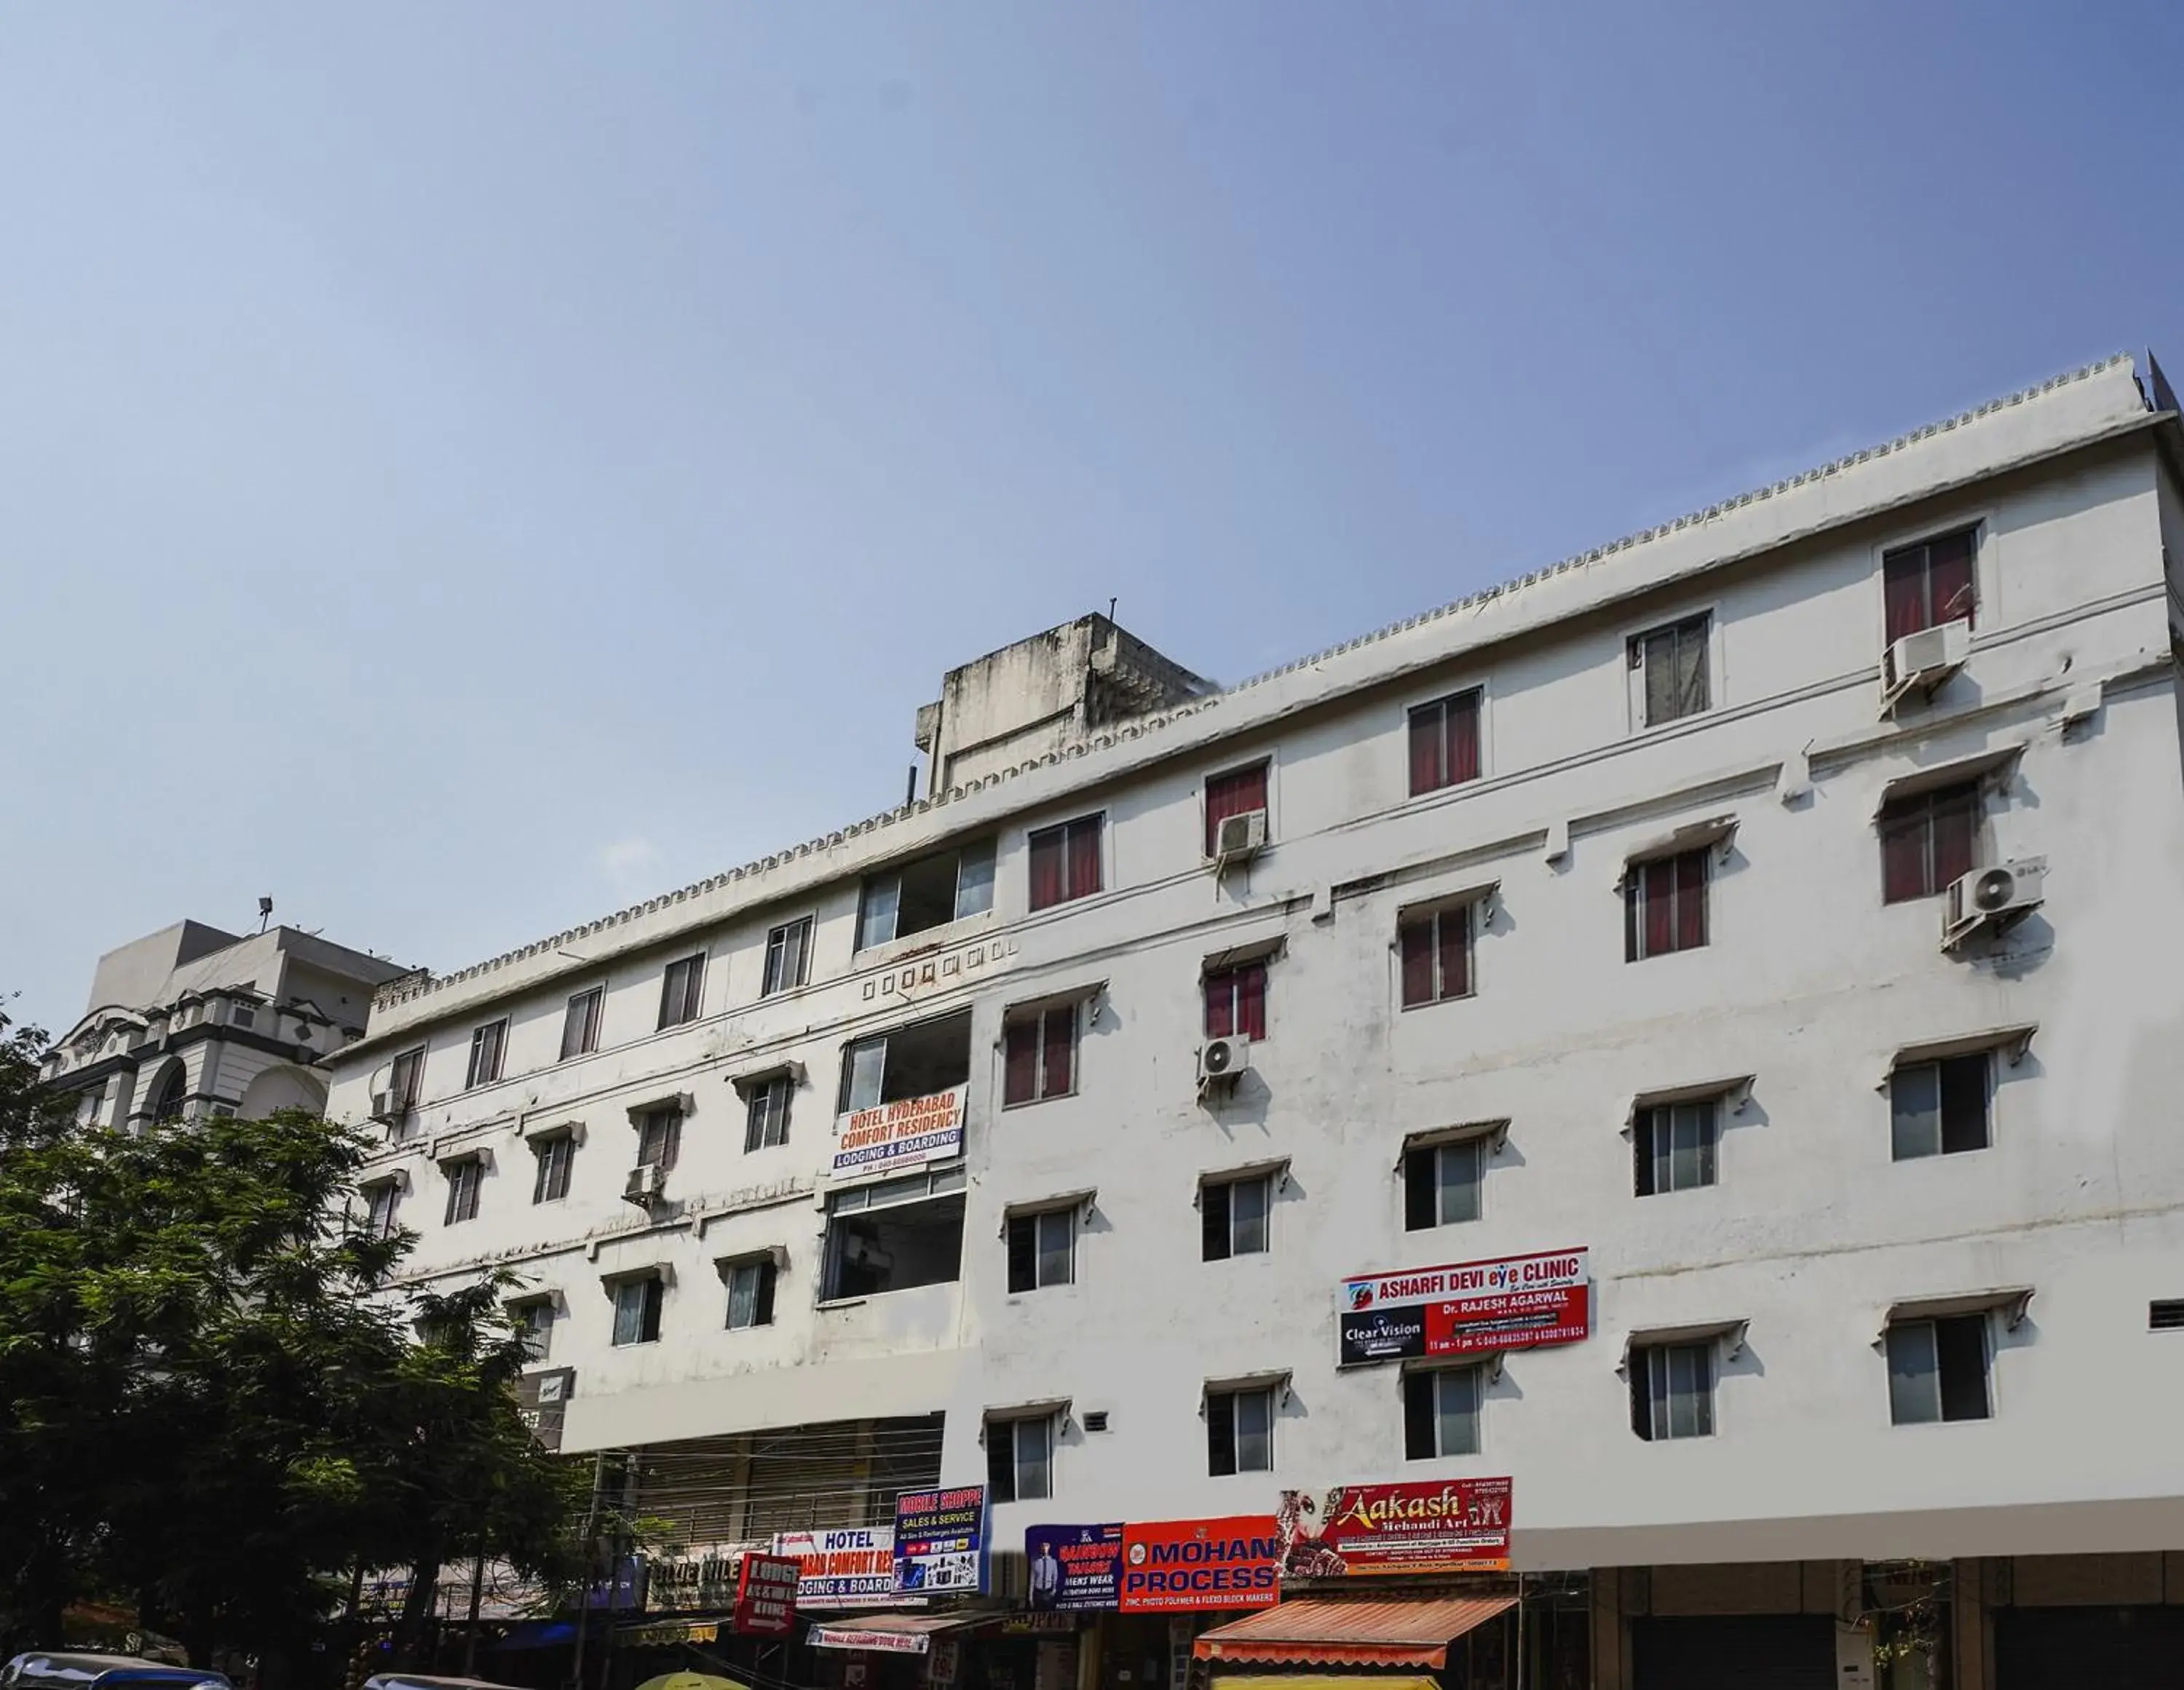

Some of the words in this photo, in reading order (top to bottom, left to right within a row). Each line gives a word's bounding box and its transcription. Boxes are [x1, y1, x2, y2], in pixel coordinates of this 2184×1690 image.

[850, 1112, 884, 1130] HOTEL
[887, 1092, 955, 1122] HYDERABAD
[841, 1124, 895, 1150] COMFORT
[896, 1108, 961, 1138] RESIDENCY
[836, 1147, 885, 1166] LODGING
[887, 1144, 895, 1156] &
[898, 1130, 957, 1154] BOARDING
[1379, 1275, 1444, 1299] ASHARFI
[1449, 1270, 1484, 1290] DEVI
[1523, 1258, 1579, 1282] CLINIC
[1443, 1304, 1458, 1314] Dr.
[1461, 1298, 1506, 1313] RAJESH
[1510, 1290, 1569, 1307] AGARWAL
[1345, 1328, 1378, 1341] Clear
[1380, 1324, 1420, 1336] Vision
[899, 1493, 938, 1515] MOBILE
[940, 1488, 982, 1511] SHOPPE
[1337, 1486, 1461, 1529] Aakash
[903, 1517, 930, 1529] SALES
[930, 1515, 937, 1526] &
[938, 1512, 975, 1525] SERVICE
[1444, 1519, 1468, 1529] Art
[825, 1531, 874, 1550] HOTEL
[1151, 1536, 1275, 1564] MOHAN
[750, 1560, 799, 1584] LODGE
[828, 1551, 874, 1575] COMFORT
[796, 1580, 834, 1595] DGING
[837, 1579, 846, 1593] &
[850, 1578, 891, 1592] BOARD
[1090, 1574, 1114, 1585] WEAR
[1126, 1566, 1274, 1592] PROCESS
[1142, 1597, 1163, 1606] PHOTO
[1195, 1595, 1200, 1605] &
[1202, 1594, 1222, 1604] FLEXO
[1223, 1594, 1245, 1603] BLOCK
[1246, 1592, 1274, 1603] MAKERS
